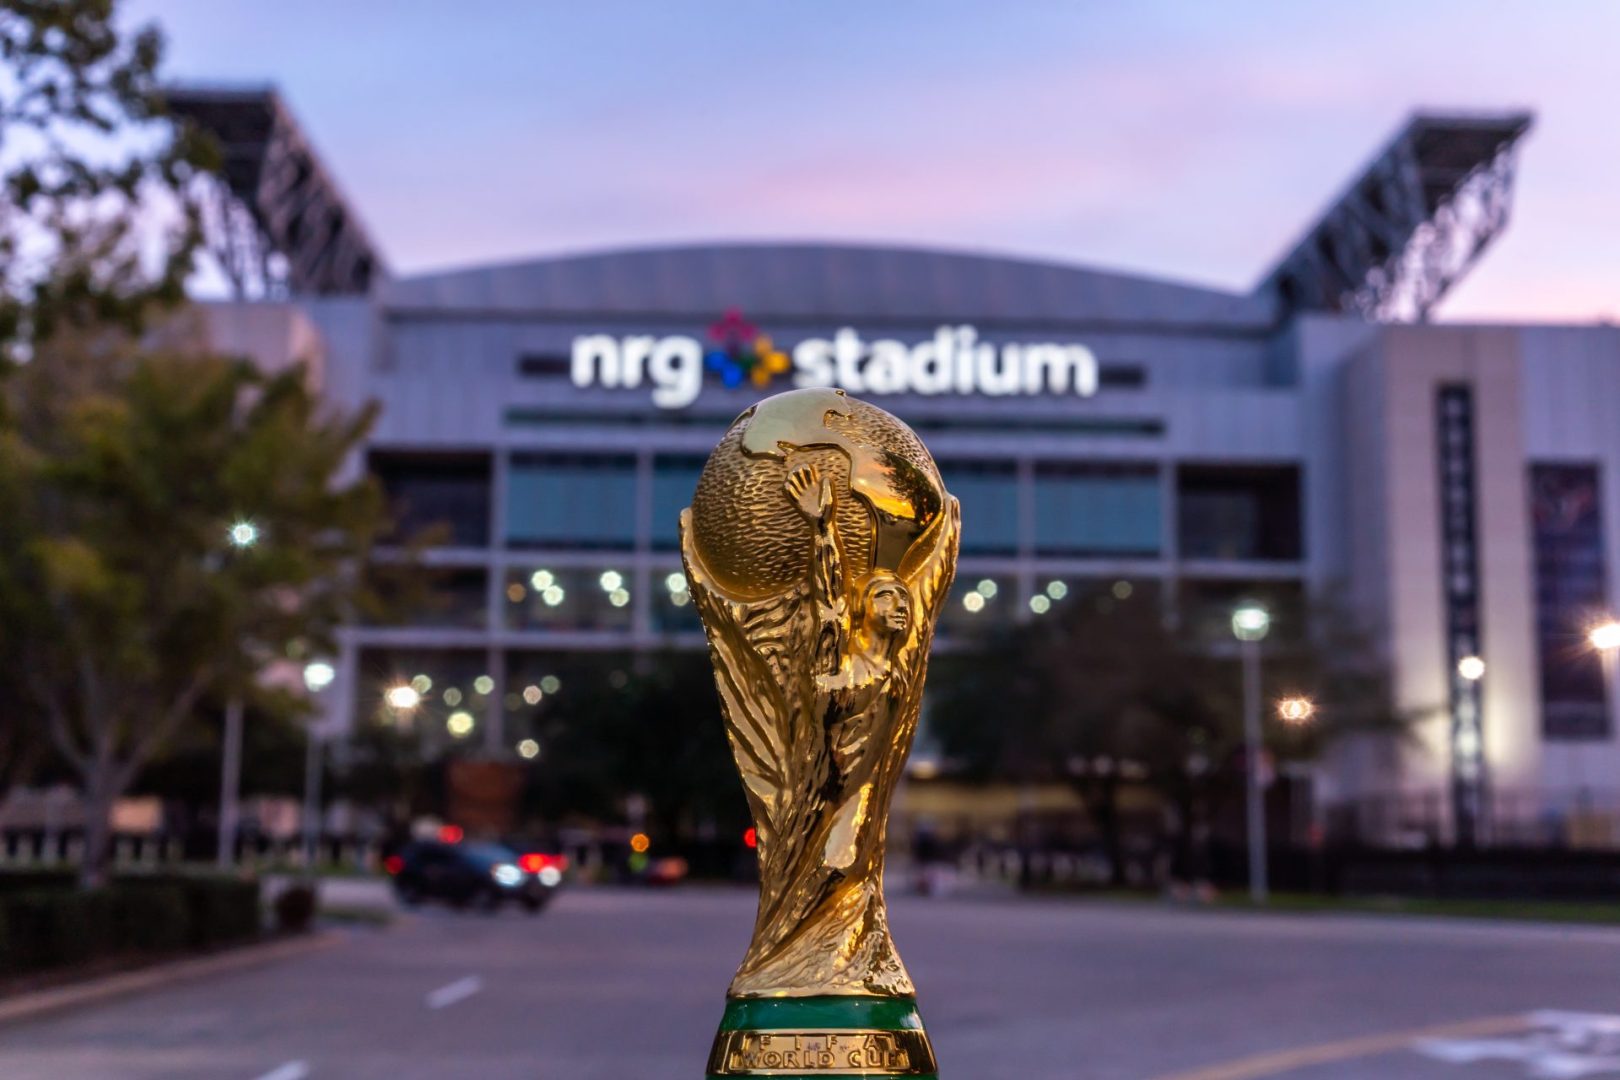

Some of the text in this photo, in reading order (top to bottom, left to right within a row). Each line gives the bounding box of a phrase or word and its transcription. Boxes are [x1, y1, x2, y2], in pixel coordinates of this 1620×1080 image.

[571, 325, 1098, 409] nrg stadium
[741, 1047, 899, 1069] WORLD CUP
